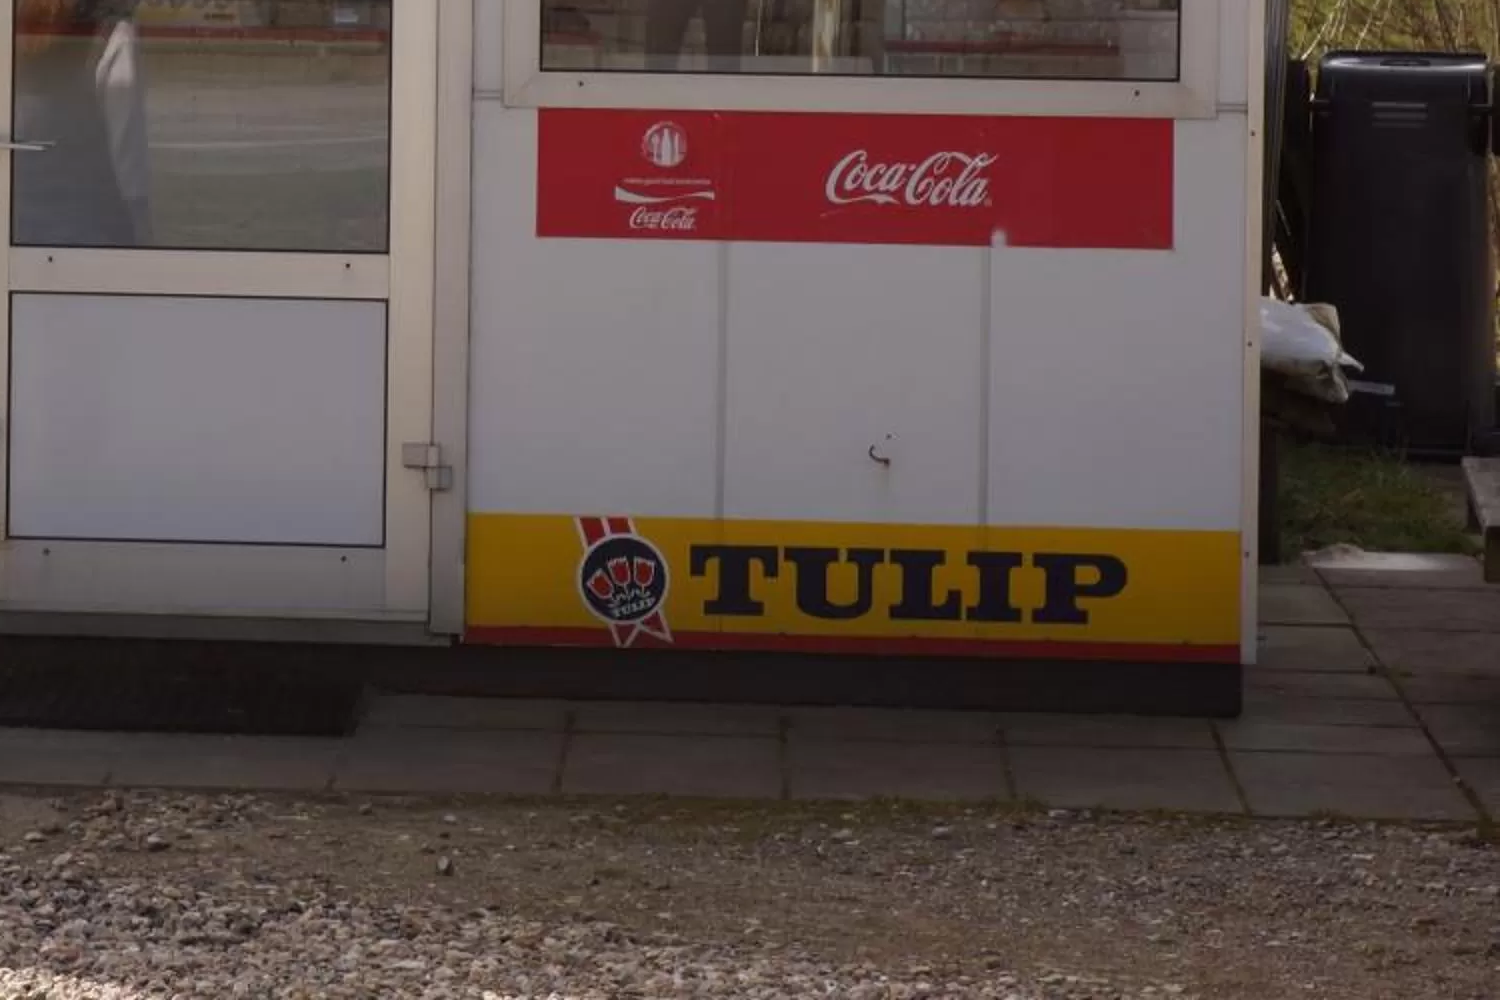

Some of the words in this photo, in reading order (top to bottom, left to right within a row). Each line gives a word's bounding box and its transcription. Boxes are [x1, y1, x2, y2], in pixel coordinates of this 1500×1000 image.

[825, 148, 999, 207] Coca-Cola
[629, 205, 698, 231] Coca-Cola
[688, 543, 1130, 626] TULIP
